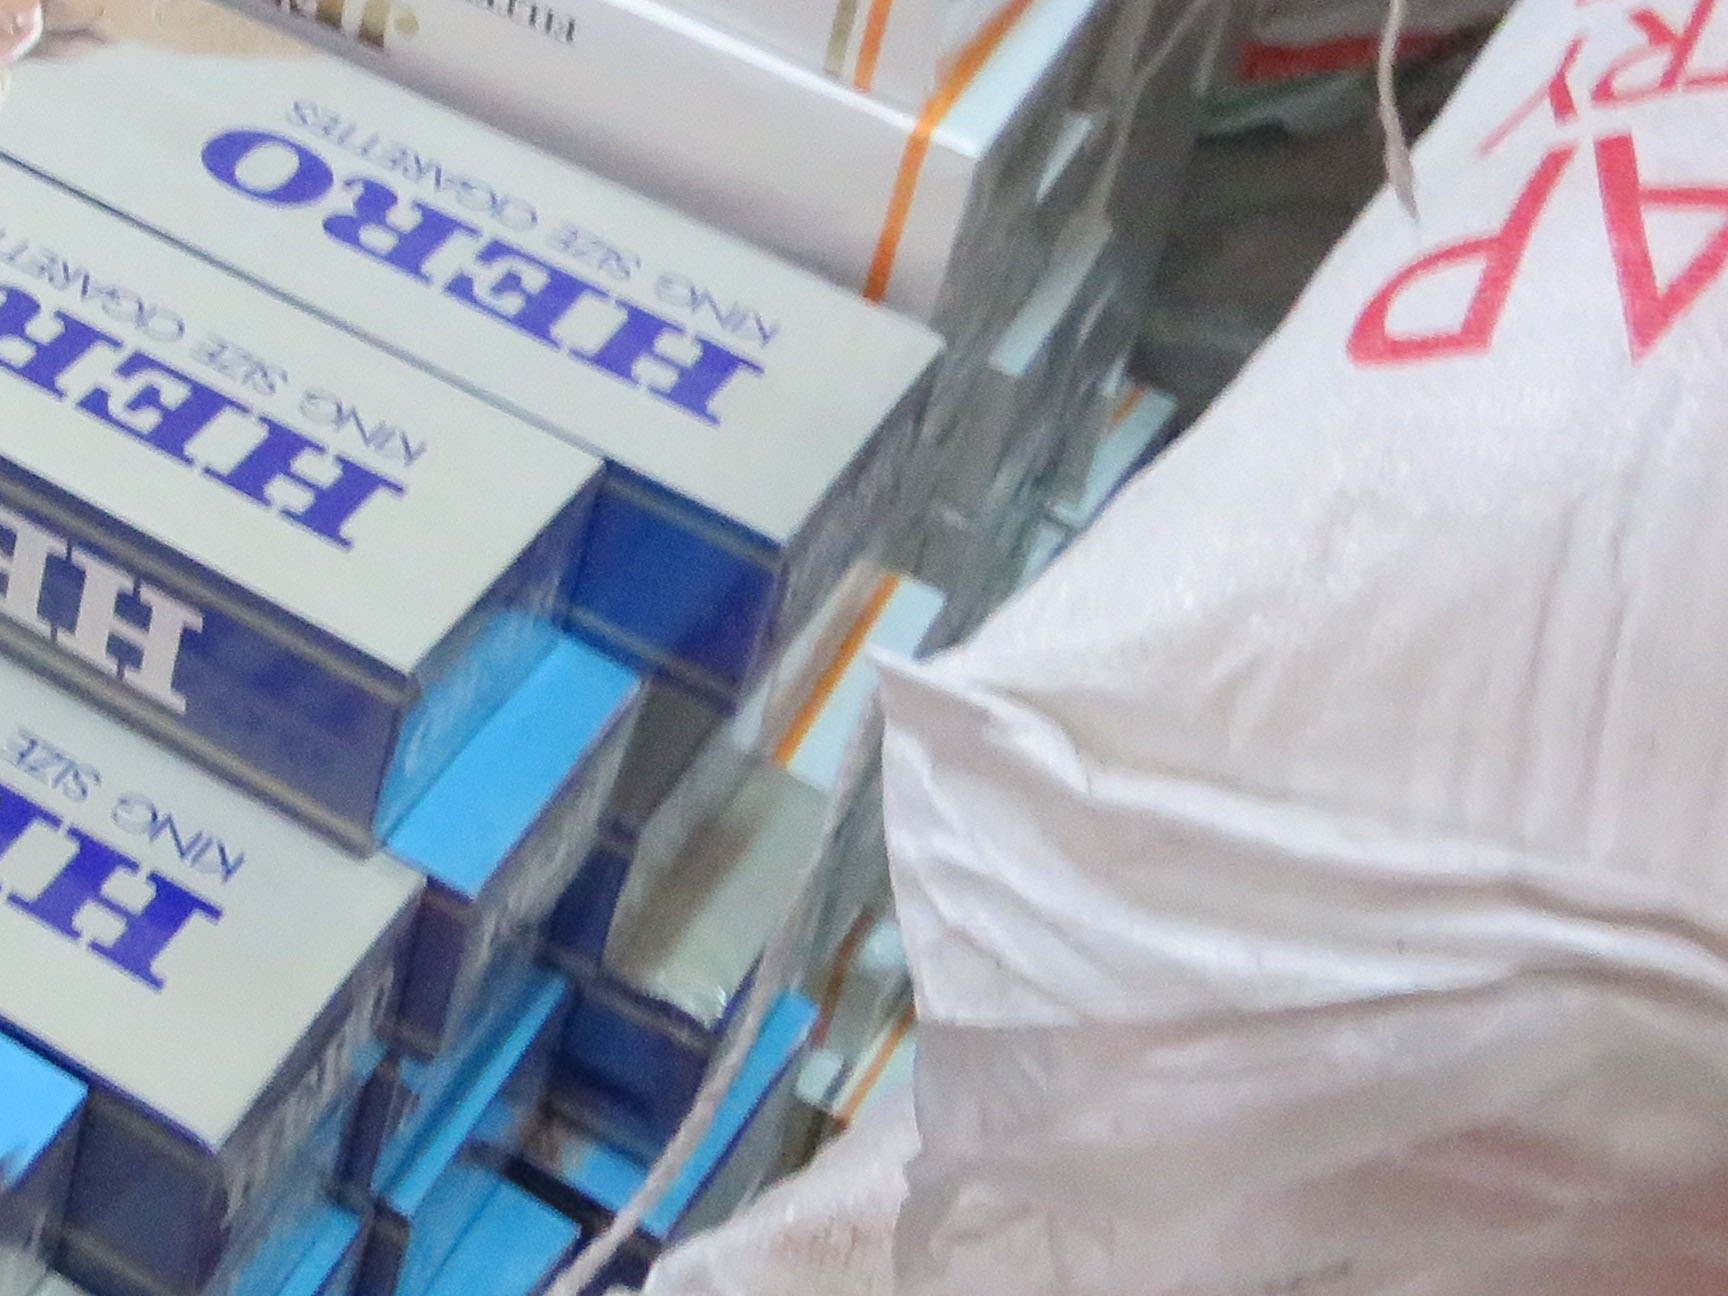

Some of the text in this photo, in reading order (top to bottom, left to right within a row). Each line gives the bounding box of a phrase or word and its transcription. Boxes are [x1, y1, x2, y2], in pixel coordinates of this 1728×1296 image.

[287, 97, 539, 234] CIGARETTES
[201, 127, 765, 428] HERO
[654, 270, 780, 350] KING
[299, 387, 428, 469] KING
[0, 727, 103, 803] SIZE
[110, 793, 245, 885] KING
